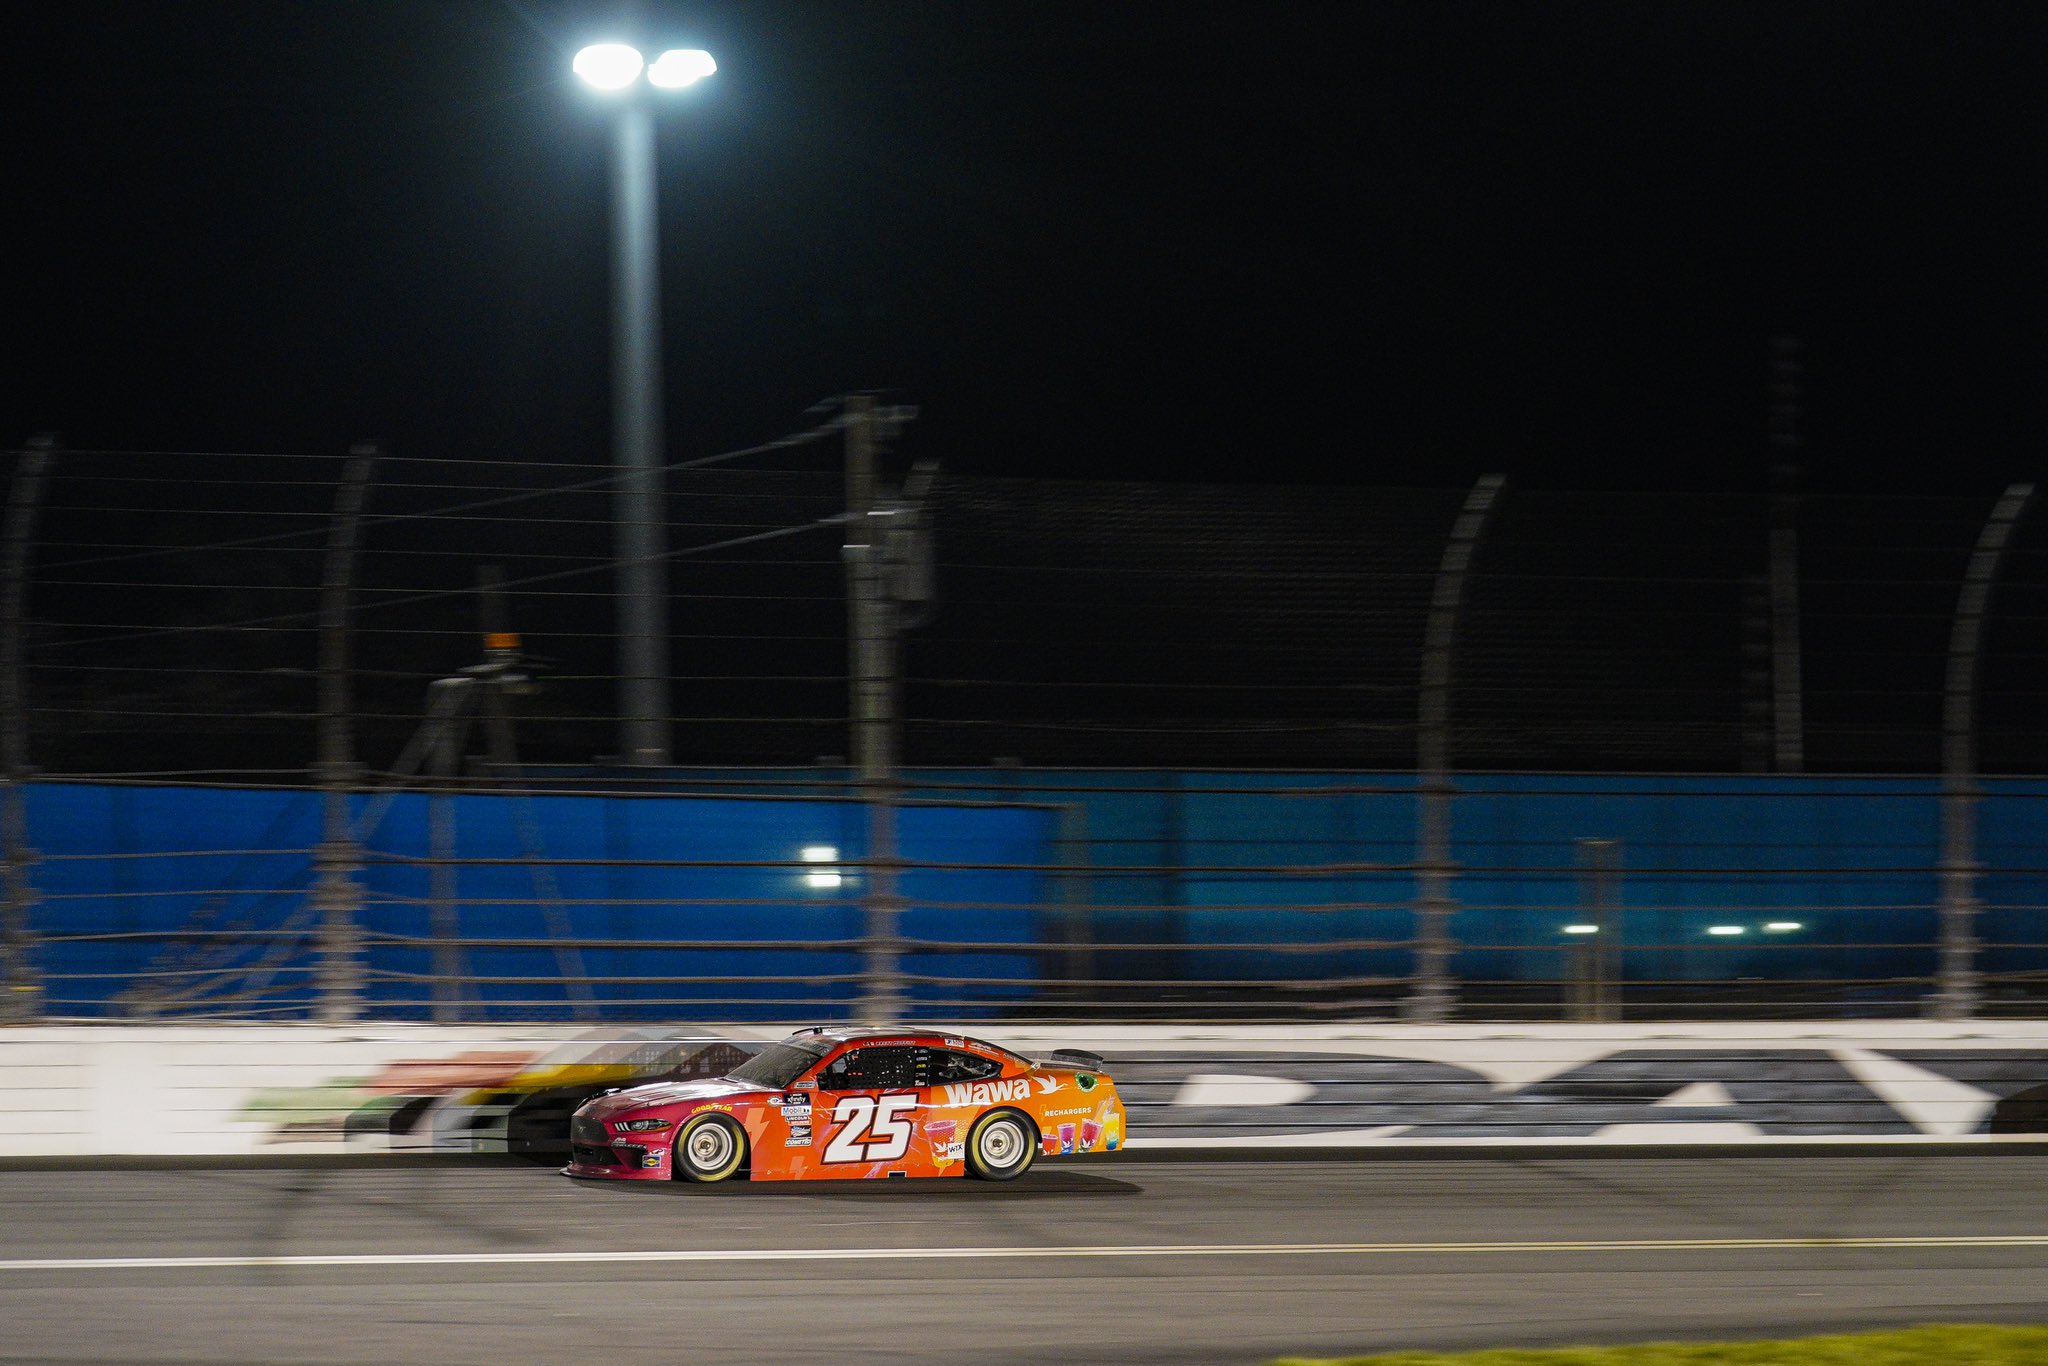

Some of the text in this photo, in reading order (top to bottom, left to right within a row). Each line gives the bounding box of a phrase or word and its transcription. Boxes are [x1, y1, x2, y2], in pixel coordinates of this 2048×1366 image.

[944, 1079, 1031, 1108] Wawa
[691, 1103, 733, 1114] GOODYEAR
[1045, 1107, 1091, 1117] RECHARGERS
[822, 1093, 919, 1164] 25
